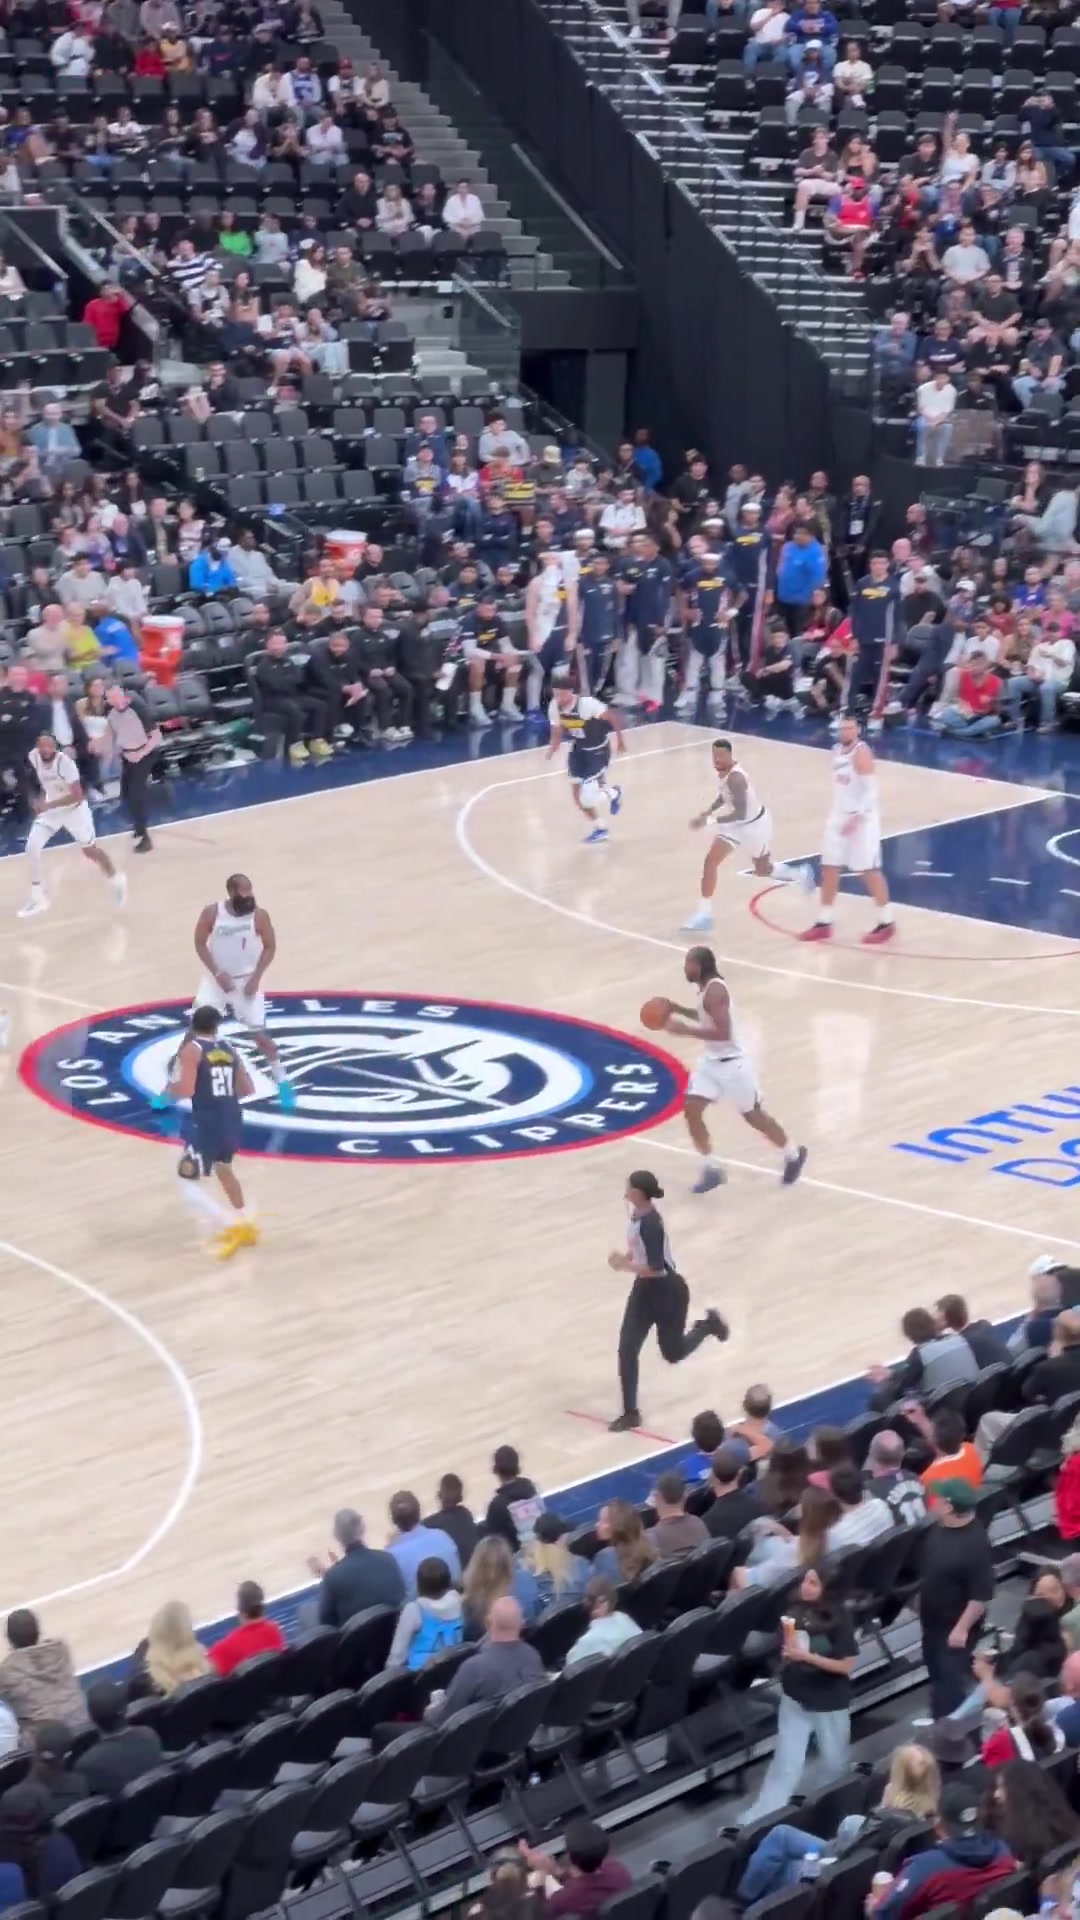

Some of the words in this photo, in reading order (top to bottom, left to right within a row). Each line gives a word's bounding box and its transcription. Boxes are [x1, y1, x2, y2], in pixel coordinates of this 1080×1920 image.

[57, 1058, 131, 1106] LOS
[211, 1066, 233, 1096] 21
[337, 1063, 659, 1154] CLIPPERS
